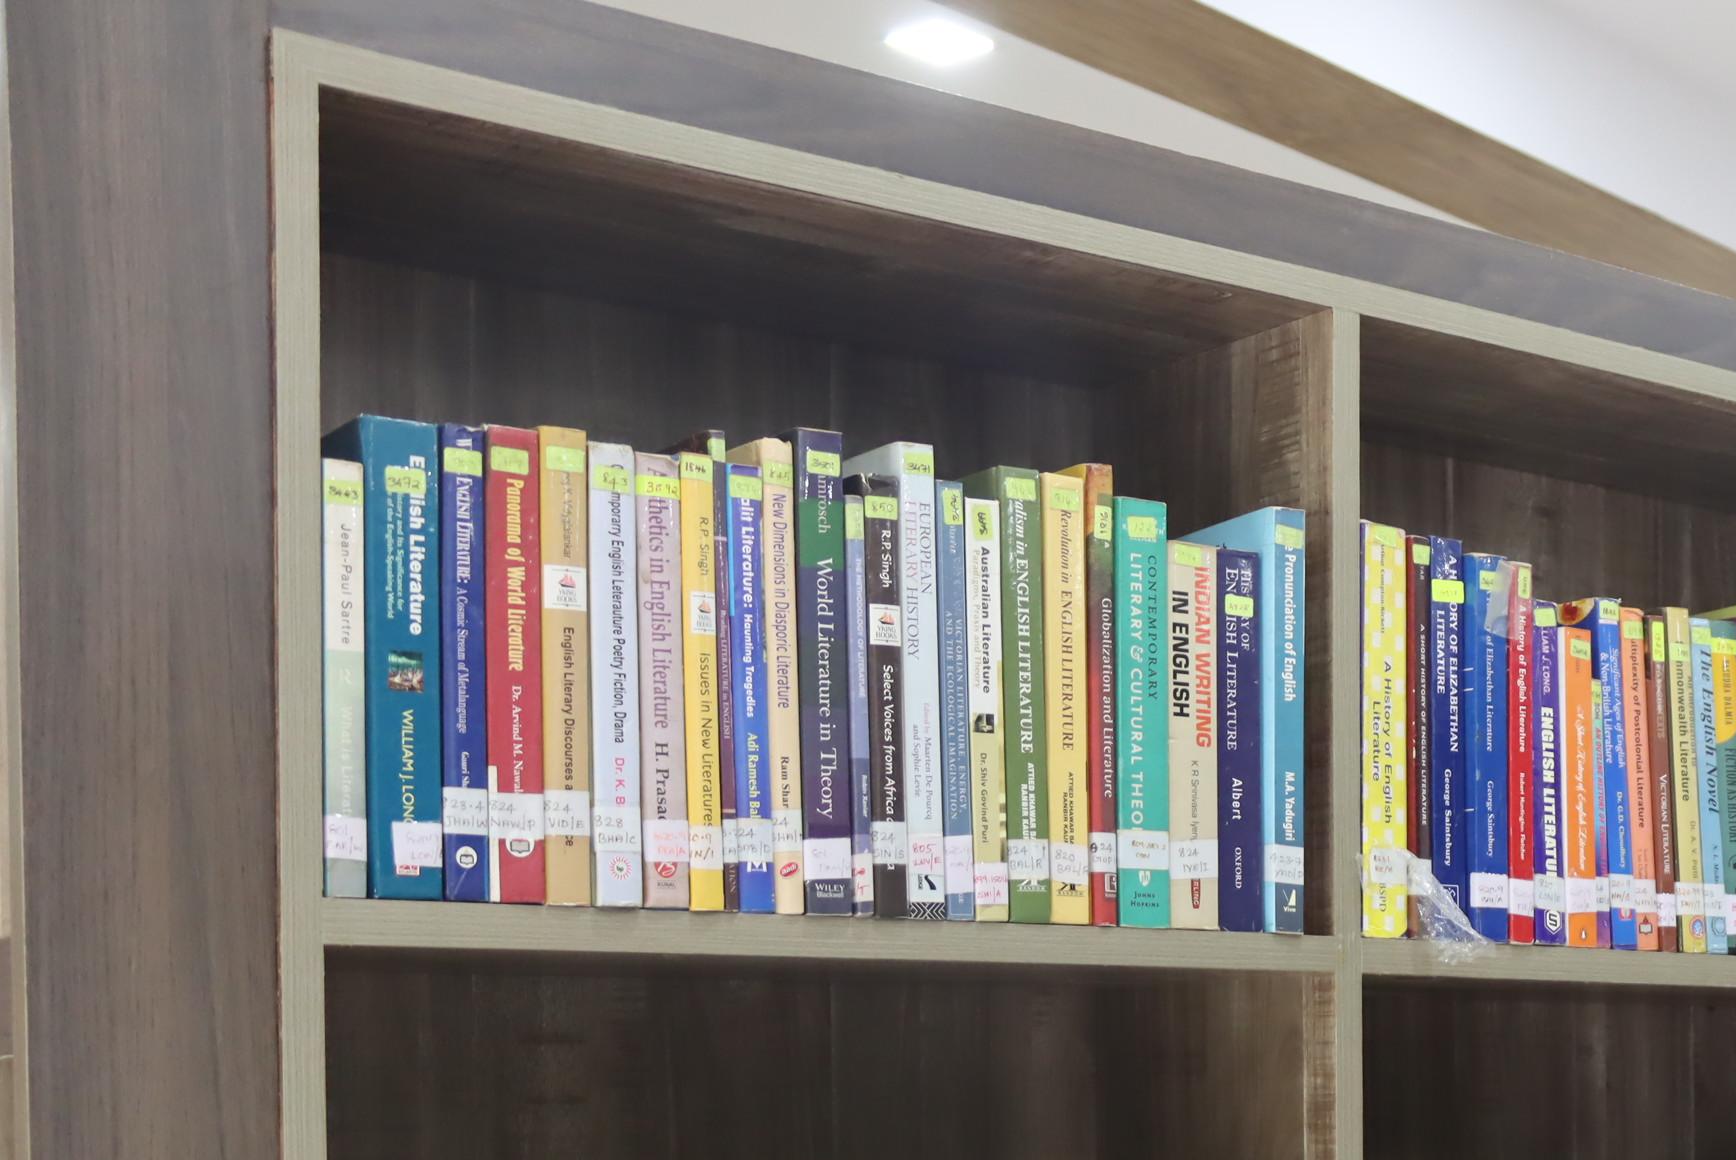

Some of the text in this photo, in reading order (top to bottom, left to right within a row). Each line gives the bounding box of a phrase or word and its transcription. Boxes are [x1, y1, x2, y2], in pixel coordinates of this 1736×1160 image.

[339, 523, 353, 644] Jean-Paul Sartre
[409, 455, 425, 635] Elish Literature
[505, 478, 526, 671] Panorama of World Literature
[906, 503, 920, 659] LITERARY HISTORY
[920, 503, 933, 594] EUROPEAN
[1130, 553, 1144, 641] LITERARY
[645, 557, 674, 728] in English Literature
[981, 547, 992, 693] Australian Literature
[1014, 540, 1033, 753] in ENGLISH LITERATURE
[1147, 555, 1158, 700] CONTEMPORARY
[1172, 590, 1191, 718] IN ENGLISH
[1193, 566, 1213, 748] INDIAN WRITING
[1282, 554, 1297, 702] Pronunciation of English
[1436, 610, 1446, 694] LITERATURE
[400, 709, 414, 781] WILLIAM J.
[561, 626, 577, 780] English Literary Discourses
[700, 653, 715, 826] Issues in New Literatures
[816, 558, 836, 819] World Literature in Theory
[883, 665, 897, 814] Select Voices from Africa
[1130, 668, 1144, 765] CULTURAL
[1225, 652, 1239, 750] LITERATURE
[1371, 701, 1382, 781] Literature
[1381, 662, 1395, 824] A History of English
[1449, 637, 1460, 752] OF ELIZABETHAN
[1541, 707, 1555, 783] ENGLISH
[1232, 777, 1243, 820] Albert
[1442, 769, 1454, 866] George Saintsbury
[1725, 748, 1736, 783] FICTION
[814, 883, 844, 892] WILEY
[1233, 846, 1243, 889] OXFORD
